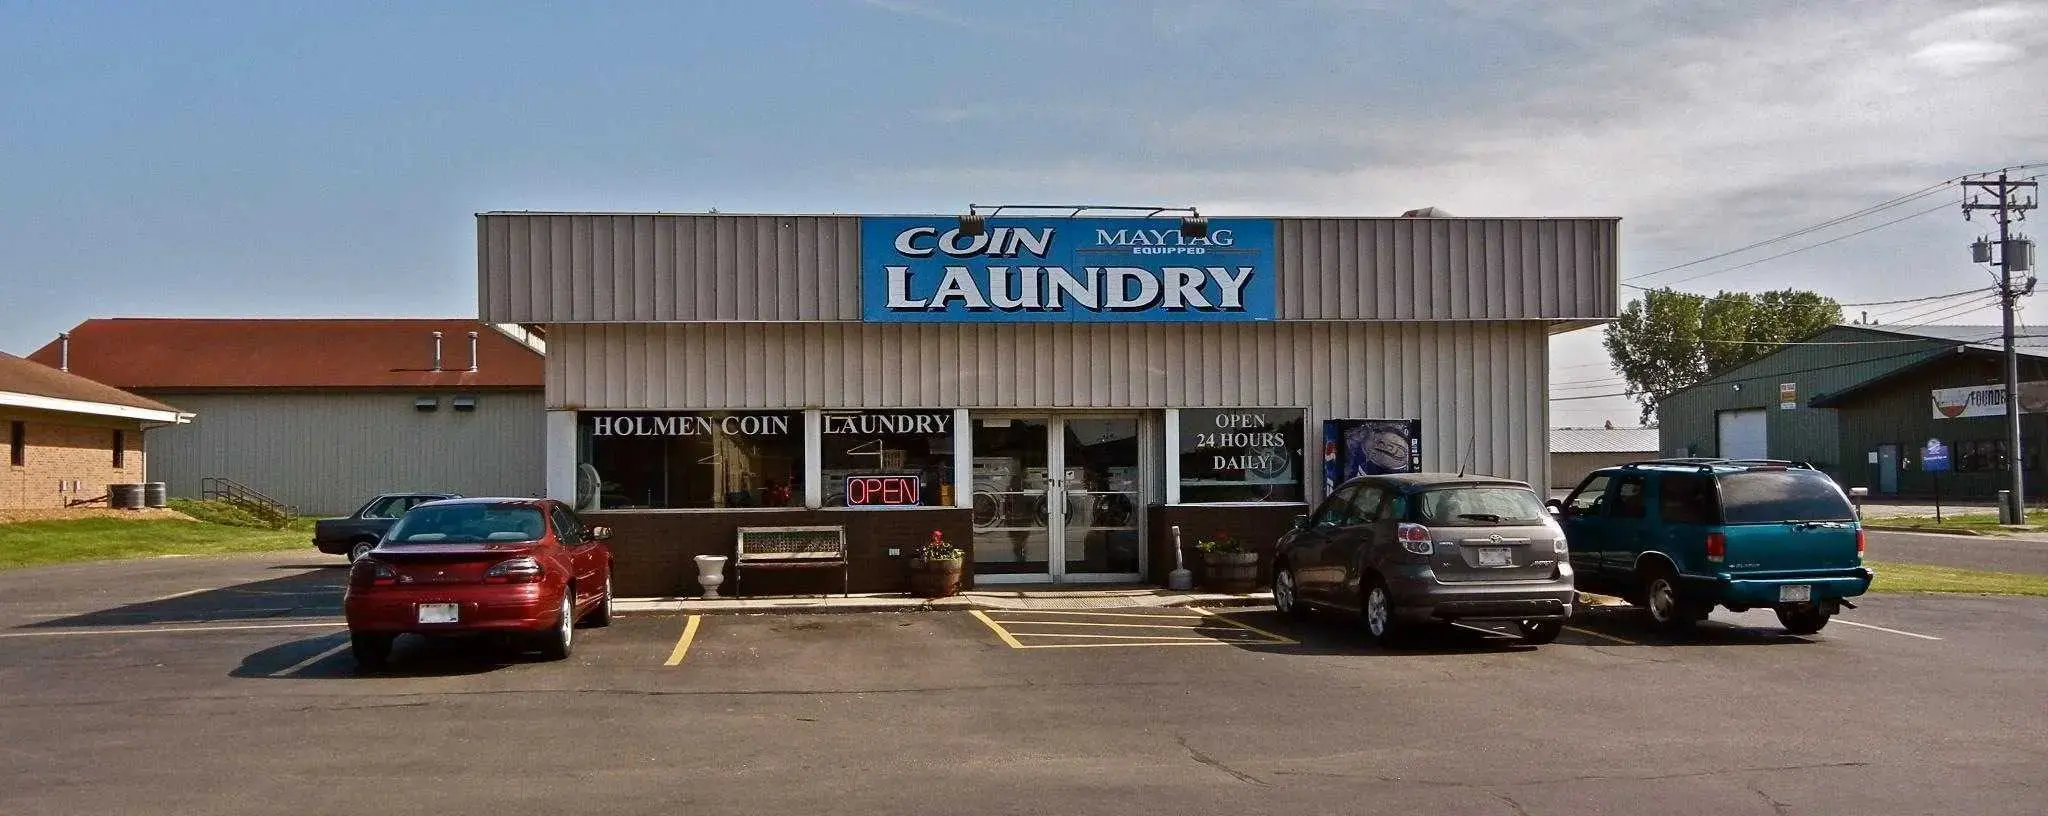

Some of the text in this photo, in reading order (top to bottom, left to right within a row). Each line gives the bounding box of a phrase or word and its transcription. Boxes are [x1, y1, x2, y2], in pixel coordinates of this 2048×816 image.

[893, 226, 1055, 258] COIN
[1095, 228, 1234, 246] MAYTAG
[1132, 247, 1206, 255] EQUIPPED
[885, 266, 1253, 312] LAUNDRY
[593, 414, 951, 436] HOLMEN COIN LAUNDRY
[1215, 413, 1266, 428] OPEN
[1196, 433, 1285, 448] 24 HOURS
[1213, 455, 1272, 470] DAILY
[848, 478, 917, 505] OPEN
